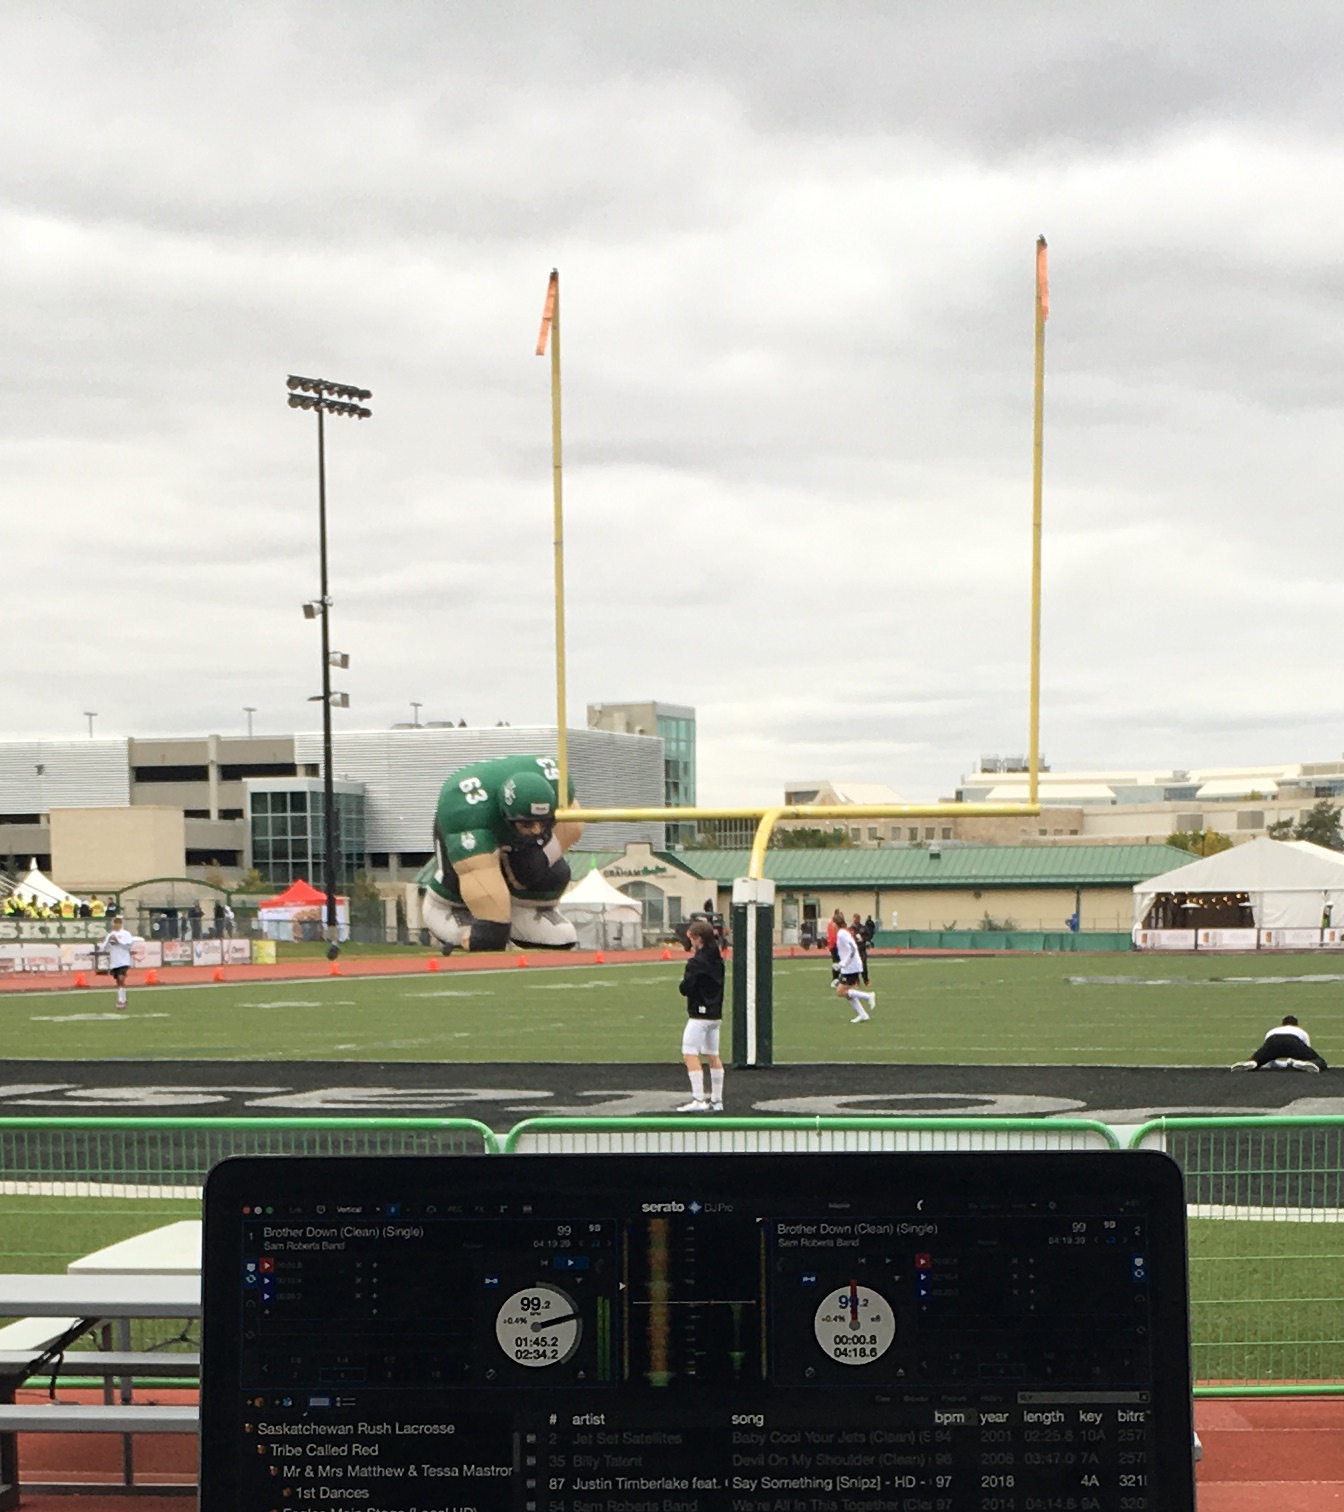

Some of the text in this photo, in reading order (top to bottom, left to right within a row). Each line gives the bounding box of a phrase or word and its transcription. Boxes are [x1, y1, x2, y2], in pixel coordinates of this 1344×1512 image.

[459, 776, 488, 805] 63
[641, 1200, 686, 1213] serato
[572, 1412, 606, 1426] artist
[731, 1414, 765, 1428] song
[934, 1410, 966, 1426] bpm
[979, 1412, 1010, 1426] year
[1023, 1409, 1065, 1426] length
[1078, 1409, 1103, 1426] key
[257, 1421, 456, 1436] Saskatchewan Rush Lacrosse
[269, 1443, 379, 1457] Tribe Called Red
[282, 1464, 460, 1478] Mr & Mrs Matthew & Tessa
[571, 1476, 689, 1491] Justin Timberlake
[732, 1474, 917, 1492] Say Something [Snipz] HD
[295, 1485, 370, 1500] 1st Dances
